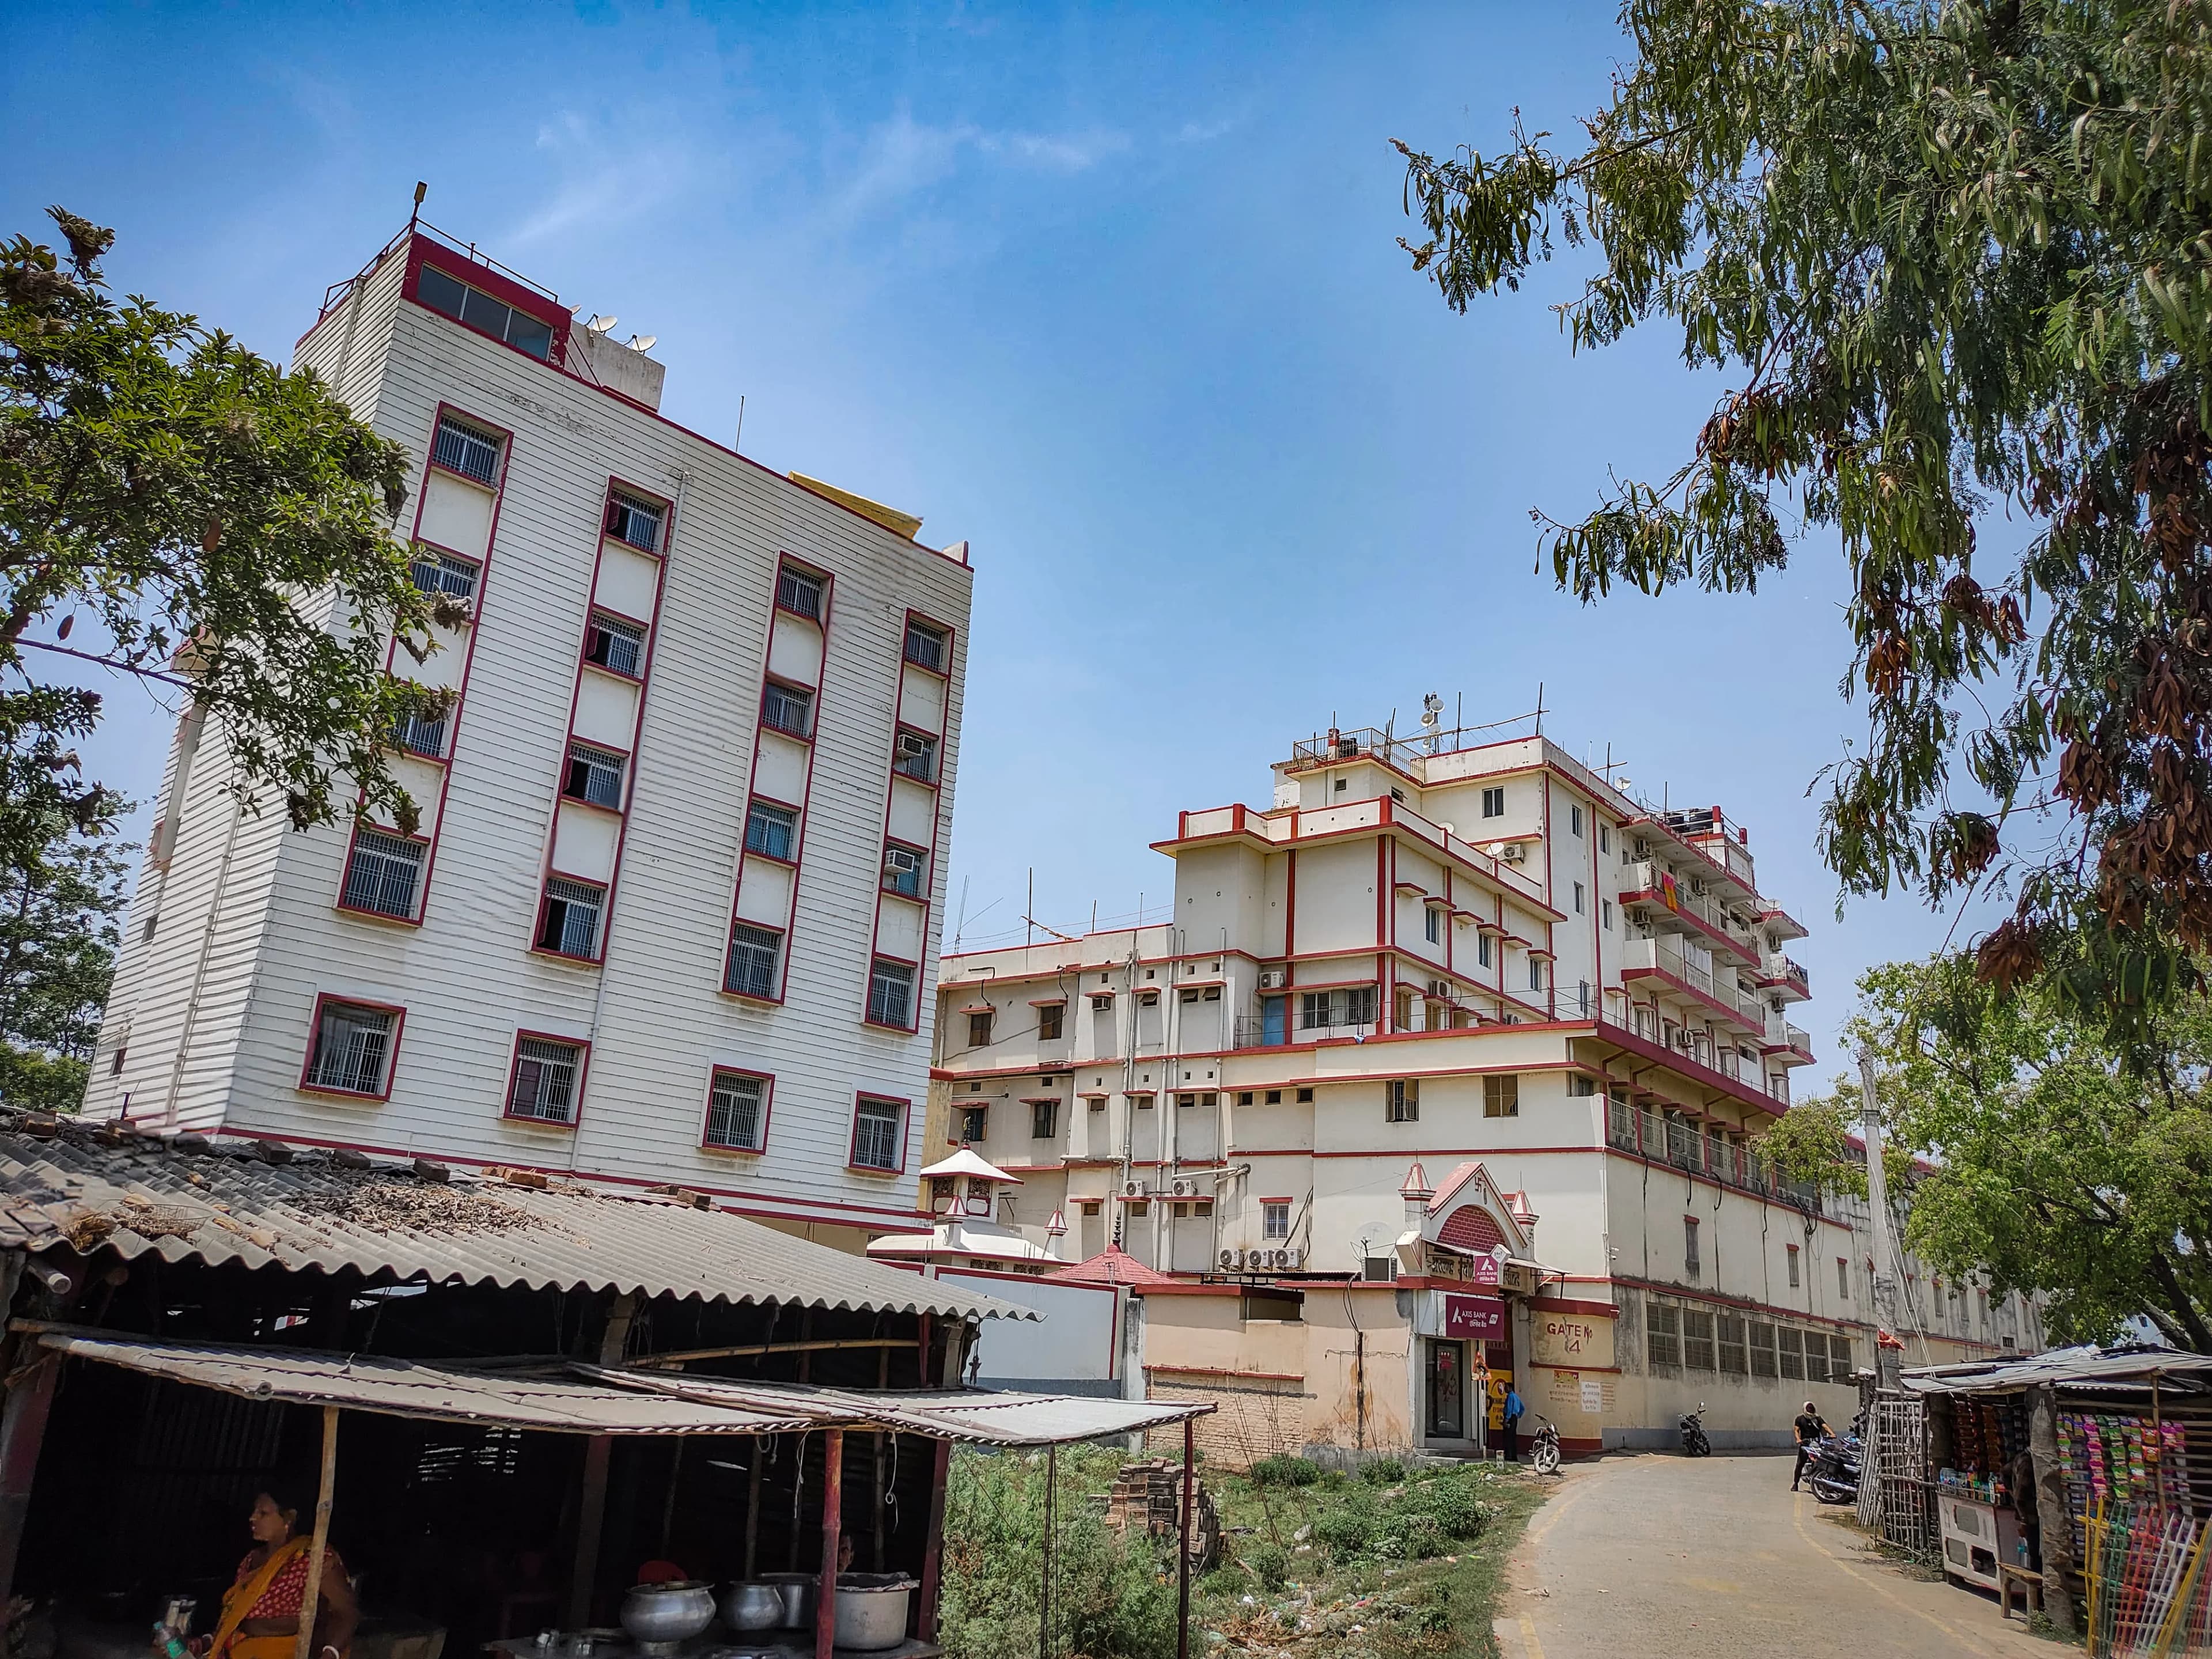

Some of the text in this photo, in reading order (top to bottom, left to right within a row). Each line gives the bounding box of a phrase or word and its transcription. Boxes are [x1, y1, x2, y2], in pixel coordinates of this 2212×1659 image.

[1461, 1310, 1487, 1319] AXIS BANK
[1547, 1322, 1581, 1337] GATE
[1569, 1339, 1581, 1354] 4
